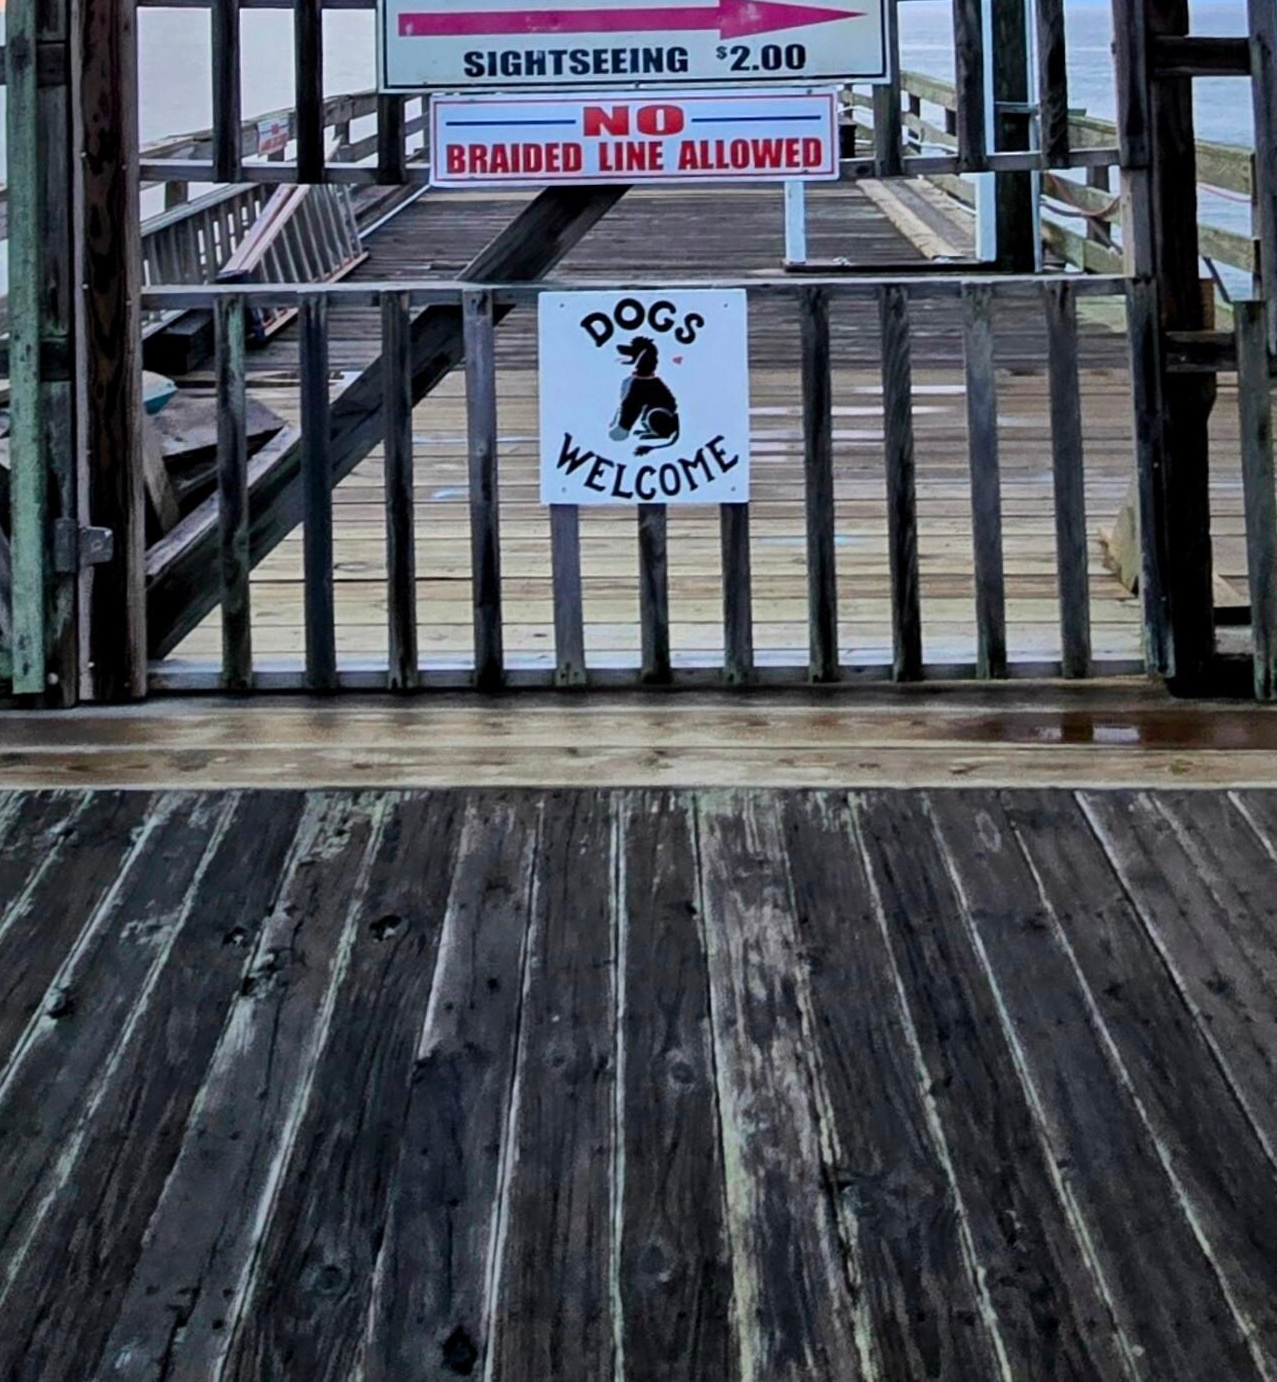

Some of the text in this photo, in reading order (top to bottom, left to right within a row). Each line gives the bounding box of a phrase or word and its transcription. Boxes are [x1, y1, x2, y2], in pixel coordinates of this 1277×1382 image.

[462, 42, 807, 78] SIGHTSEEING $2.00
[581, 104, 686, 137] NO
[445, 136, 823, 175] BRAIDED LINE ALLOWED
[580, 297, 705, 348] DOGS
[555, 432, 740, 501] WELCOME
